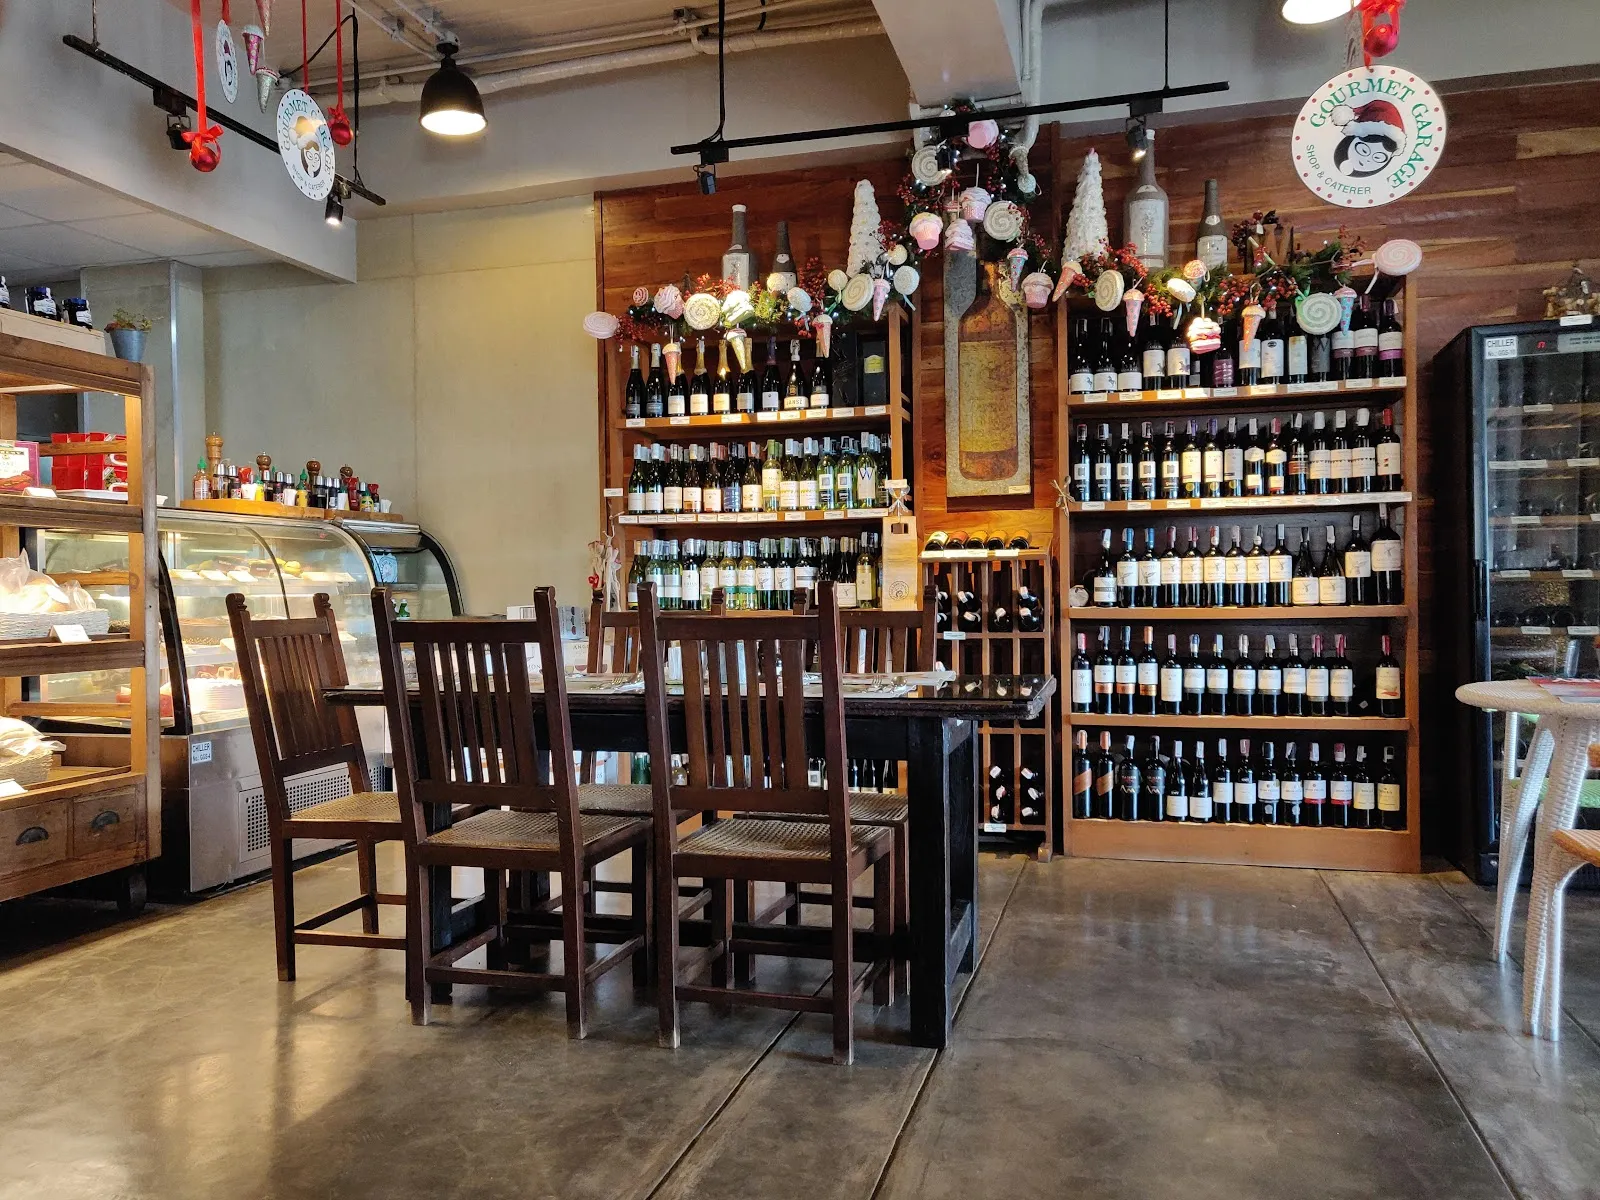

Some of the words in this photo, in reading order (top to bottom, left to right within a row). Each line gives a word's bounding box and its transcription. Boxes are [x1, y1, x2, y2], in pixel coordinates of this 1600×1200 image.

[283, 99, 309, 152] GOURMET
[1309, 77, 1416, 128] GOURMET
[1387, 103, 1433, 189] GARAGE
[1306, 144, 1320, 171] SHOP
[1316, 171, 1325, 179] &
[1324, 177, 1372, 195] CATERER
[1487, 338, 1515, 348] CHILLER
[193, 743, 210, 752] CHILLER
